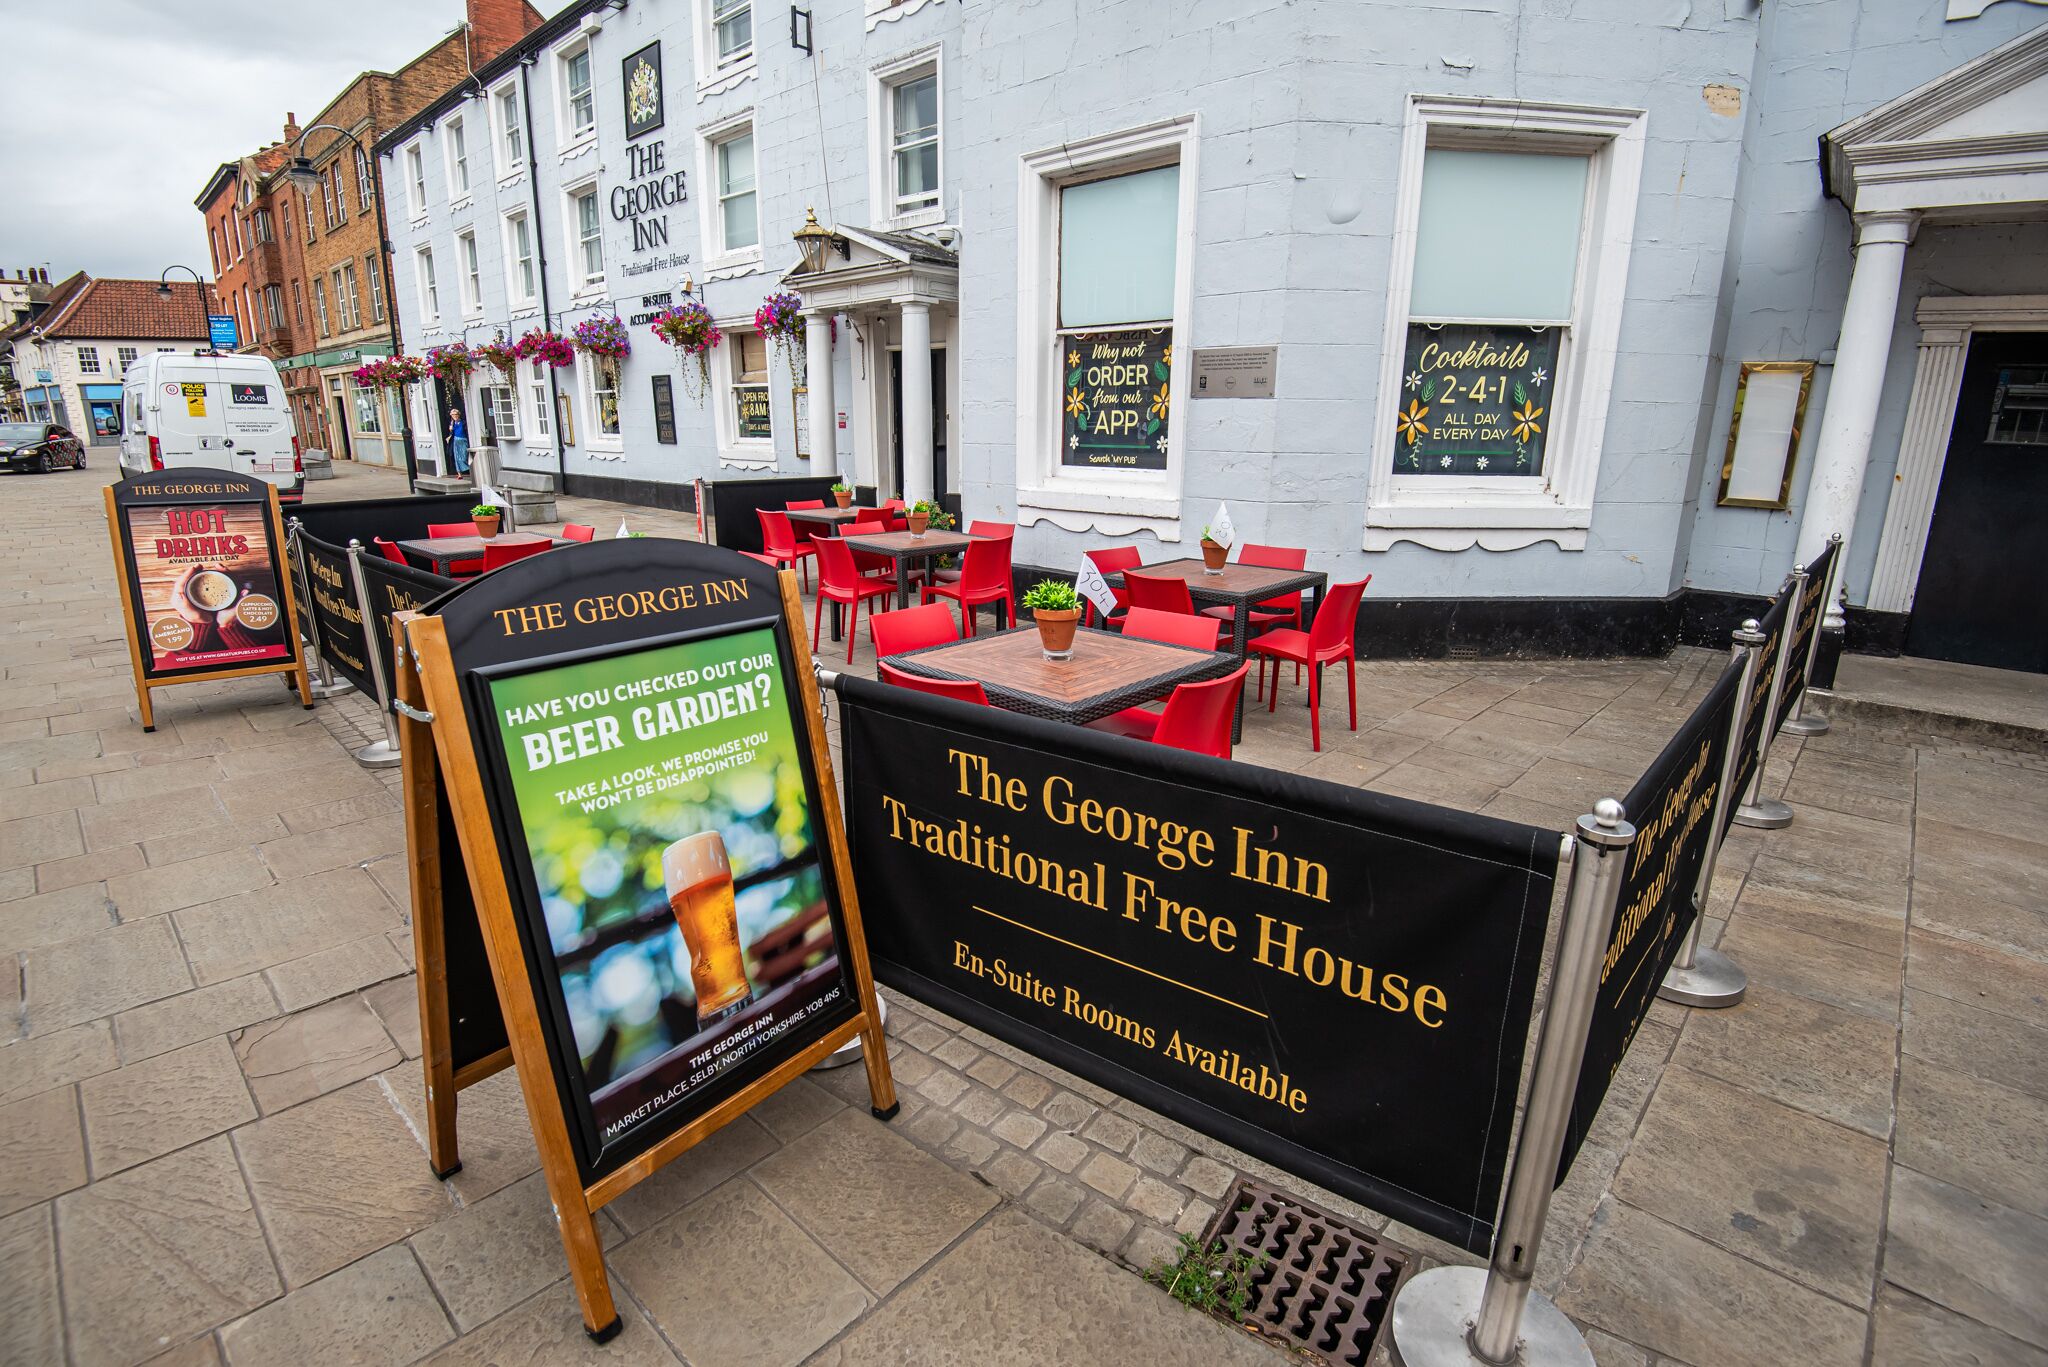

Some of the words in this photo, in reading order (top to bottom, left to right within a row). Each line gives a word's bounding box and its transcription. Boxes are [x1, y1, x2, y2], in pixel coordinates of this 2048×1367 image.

[625, 140, 665, 181] THE
[610, 170, 687, 221] GEORGE
[632, 215, 668, 252] INN
[621, 258, 654, 277] Traditional
[654, 257, 668, 271] Free
[669, 253, 690, 268] House
[1092, 343, 1119, 364] Why
[1121, 341, 1147, 357] not
[1420, 340, 1530, 373] Cocktails
[1087, 365, 1148, 387] ORDER
[1440, 375, 1507, 404] 2-4-1
[234, 394, 266, 402] LOOMIS
[743, 392, 757, 402] OPEN
[758, 391, 769, 401] FRO
[750, 403, 767, 416] 8AM
[1092, 388, 1120, 409] from
[1122, 390, 1143, 404] our
[1093, 410, 1138, 435] APP
[1443, 413, 1468, 425] ALL
[1474, 413, 1501, 425] DAY
[1433, 428, 1478, 440] EVERY
[1481, 428, 1510, 440] DAY
[1089, 454, 1111, 464] Search
[132, 485, 161, 496] THE
[164, 484, 223, 495] GEORGE
[225, 483, 250, 493] INN
[167, 509, 229, 536] HOT
[155, 534, 249, 559] DRINKS
[168, 556, 209, 564] AVAILABLE
[385, 584, 405, 611] The
[494, 602, 567, 637] THE
[573, 584, 699, 625] GEORGE
[701, 577, 750, 606] INN
[250, 615, 268, 623] 2.49
[154, 627, 192, 639] AMERICANO
[167, 635, 183, 644] 1.99
[505, 698, 564, 727] HAVE
[565, 688, 611, 713] YOU
[613, 670, 699, 702] CHECKED
[701, 660, 737, 682] OUT
[740, 653, 775, 673] OUR
[521, 715, 625, 771] BEER
[632, 673, 772, 741] GARDEN?
[555, 782, 598, 806] TAKE
[600, 780, 611, 794] A
[661, 757, 683, 773] WE
[685, 737, 742, 765] PROMISE
[742, 731, 769, 747] YOU
[580, 787, 633, 814] WON'T
[636, 781, 655, 799] BE
[656, 749, 757, 791] DISAPPOINTED!
[948, 747, 1029, 813] The
[1042, 774, 1216, 871] George
[1230, 826, 1332, 903] Inn
[1629, 820, 1658, 882] The
[1660, 763, 1697, 839] George
[883, 795, 1109, 911] Traditional
[1121, 871, 1238, 953] Free
[1252, 913, 1448, 1029] House
[1601, 850, 1669, 985] aditional
[953, 940, 1057, 1007] En-Suite
[1062, 986, 1156, 1050] Rooms
[1163, 1028, 1308, 1114] Available
[689, 1049, 713, 1069] THE
[712, 1024, 755, 1056] GEORGE
[755, 1013, 774, 1031] INN
[606, 1102, 652, 1138] MARKET
[722, 1040, 757, 1067] NORTH
[806, 998, 824, 1016] YO8
[823, 987, 841, 1004] 4NS
